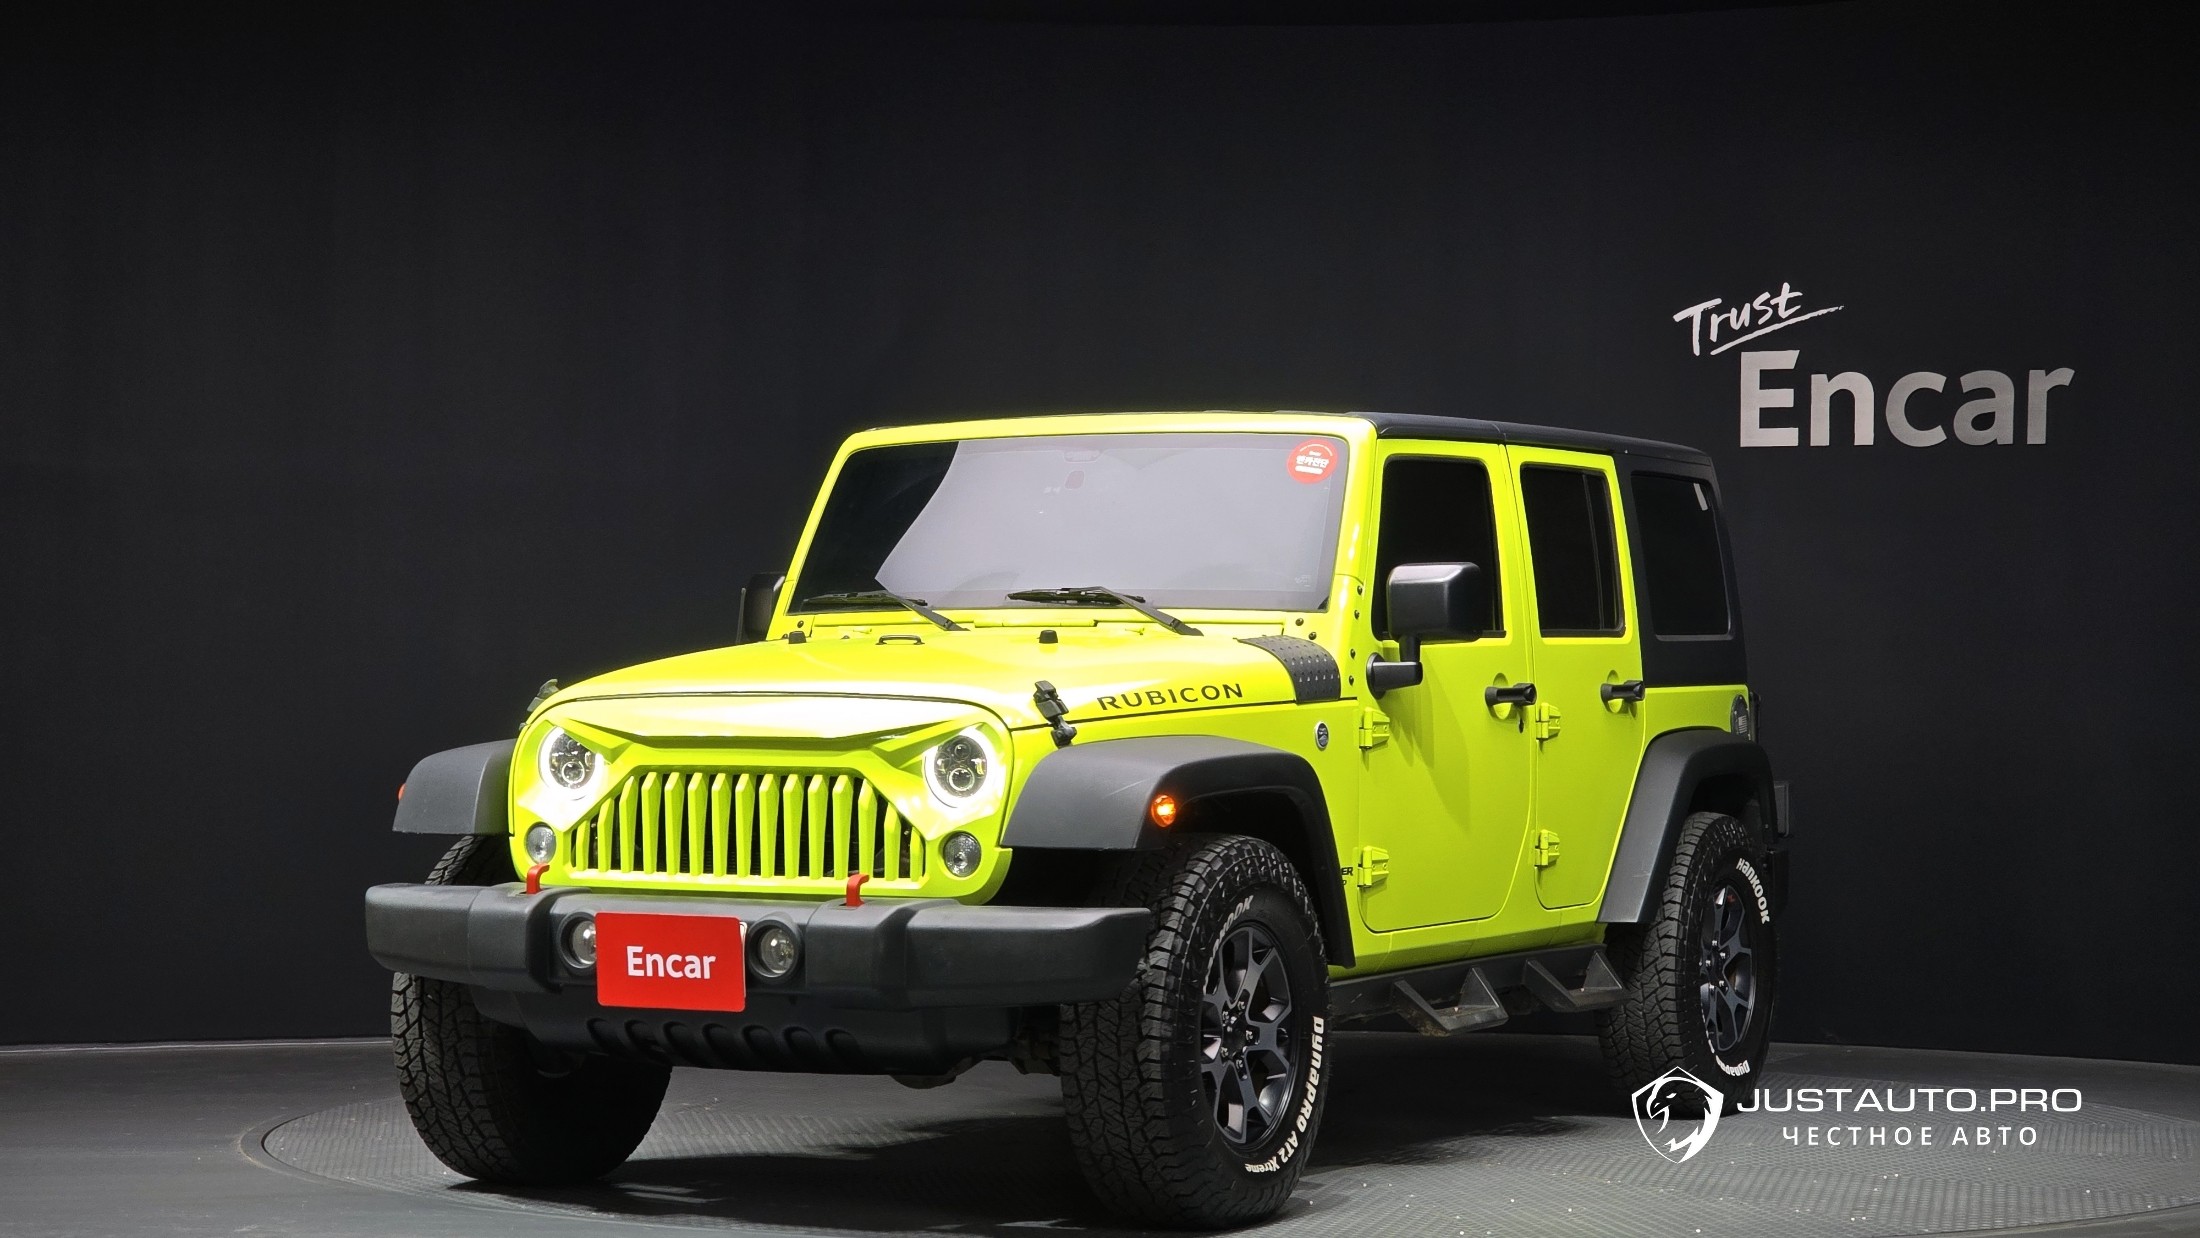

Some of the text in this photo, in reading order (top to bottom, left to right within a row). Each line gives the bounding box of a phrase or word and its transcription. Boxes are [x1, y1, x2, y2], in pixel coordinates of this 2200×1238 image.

[1673, 282, 1804, 356] Trust
[1740, 350, 2075, 447] Encar
[1096, 683, 1243, 710] RUBICON
[626, 945, 716, 979] Encar
[1245, 1155, 1281, 1173] Xtreme
[1276, 1130, 1299, 1164] AT2
